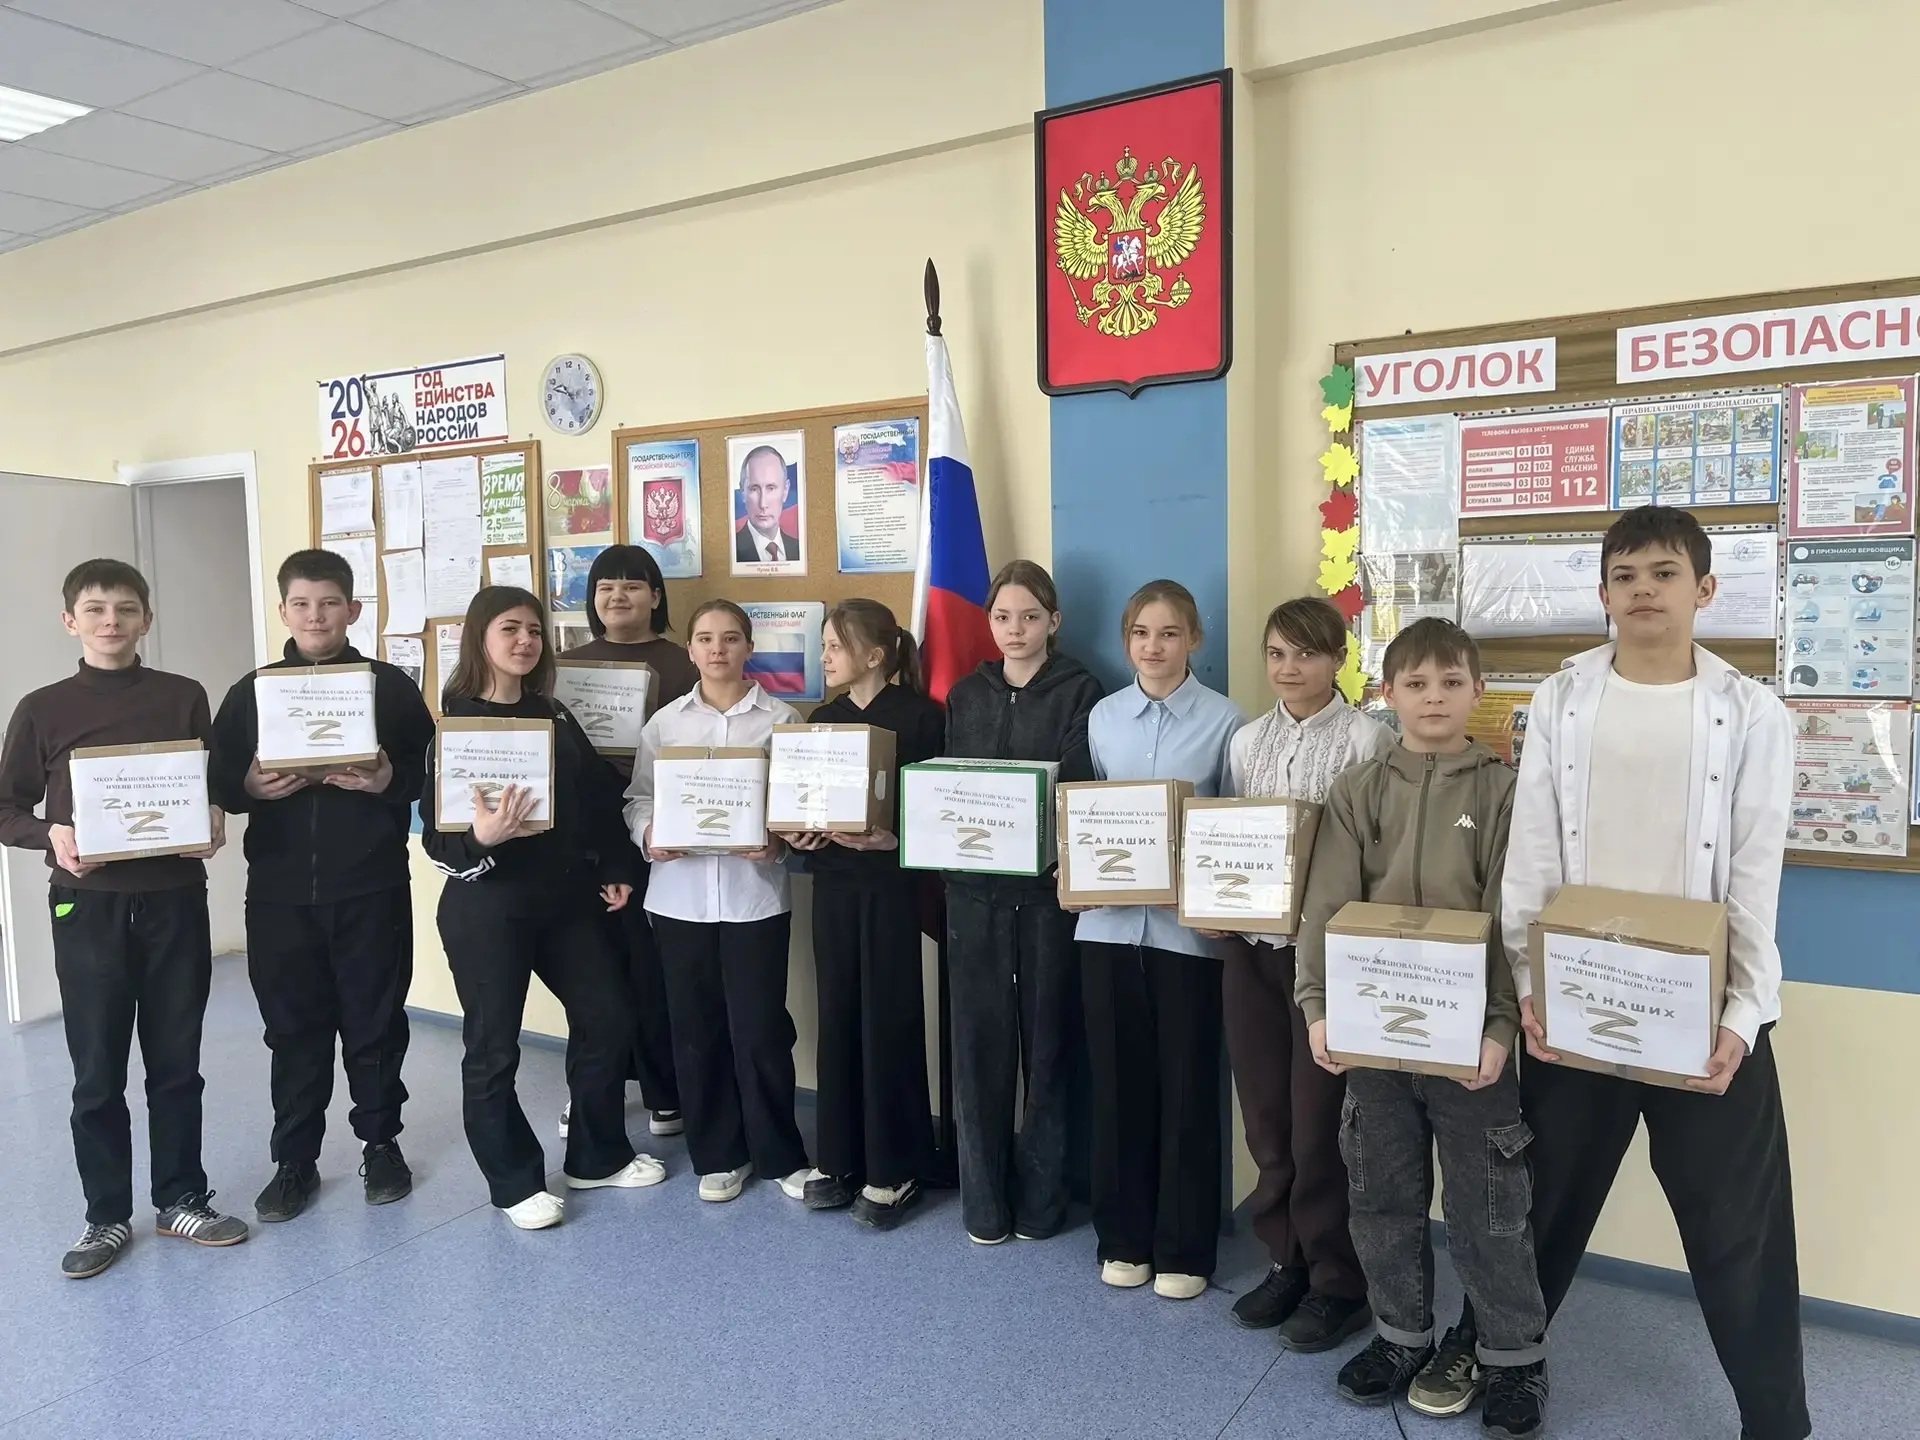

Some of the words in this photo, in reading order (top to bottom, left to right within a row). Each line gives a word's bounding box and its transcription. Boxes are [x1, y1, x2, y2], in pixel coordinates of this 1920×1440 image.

[1631, 307, 1920, 372] БЕЗОПАСН
[414, 370, 443, 389] ГОД
[1364, 348, 1544, 398] УГОЛОК
[329, 377, 363, 420] 20
[415, 382, 495, 409] ЕДИНСТВА
[416, 402, 487, 426] НАРОДОВ
[1622, 406, 1662, 415] ПРАВИЛА
[1663, 402, 1700, 412] ЛИЧНОЙ
[1703, 396, 1773, 409] БЕЗОПАСНОСТИ
[331, 418, 365, 458] 26
[416, 422, 479, 444] РОССИИ
[861, 428, 915, 440] ГОСУДАРСТВЕННЫЙ
[632, 452, 680, 462] ГОСУДАРСТВЕННЫЙ
[1535, 446, 1550, 454] 101
[1565, 445, 1594, 454] ЕДИНАЯ
[1535, 462, 1550, 470] 102
[1565, 455, 1594, 463] СЛУЖБА
[1561, 464, 1598, 473] СПАСЕНИЯ
[483, 471, 525, 496] ВРЕМЯ
[1535, 478, 1549, 486] 103
[1561, 477, 1598, 497] 112
[548, 474, 560, 509] 8
[1535, 494, 1549, 502] 104
[486, 518, 502, 532] 2,5
[594, 704, 633, 712] НАШИХ
[102, 798, 132, 810] ZА
[137, 799, 191, 808] НАШИХ
[707, 799, 752, 808] НАШИХ
[940, 810, 965, 823] ZА
[969, 816, 1015, 828] НАШИХ
[1076, 832, 1102, 845] ZА
[1107, 837, 1156, 845] НАШИХ
[1196, 855, 1220, 868] ZА
[1225, 861, 1274, 870] НАШИХ
[1347, 954, 1371, 964] МКОУ
[1452, 970, 1474, 979] СОШ
[1361, 966, 1391, 976] ИМЕНИ
[1392, 970, 1436, 983] ПЕНЬКОВА
[1549, 952, 1576, 963] МКОУ
[1577, 958, 1666, 985] «ВЯЗНОВАТОВСКАЯ
[1668, 979, 1693, 989] СОШ
[1565, 965, 1598, 978] ИМЕНИ
[1599, 973, 1649, 991] ПЕНЬКОВА
[1651, 985, 1674, 995] С.В.»
[1356, 983, 1389, 1000] ZА
[1396, 992, 1459, 1010] НАШИХ
[1560, 981, 1596, 1002] ZА
[1603, 996, 1676, 1019] НАШИХ
